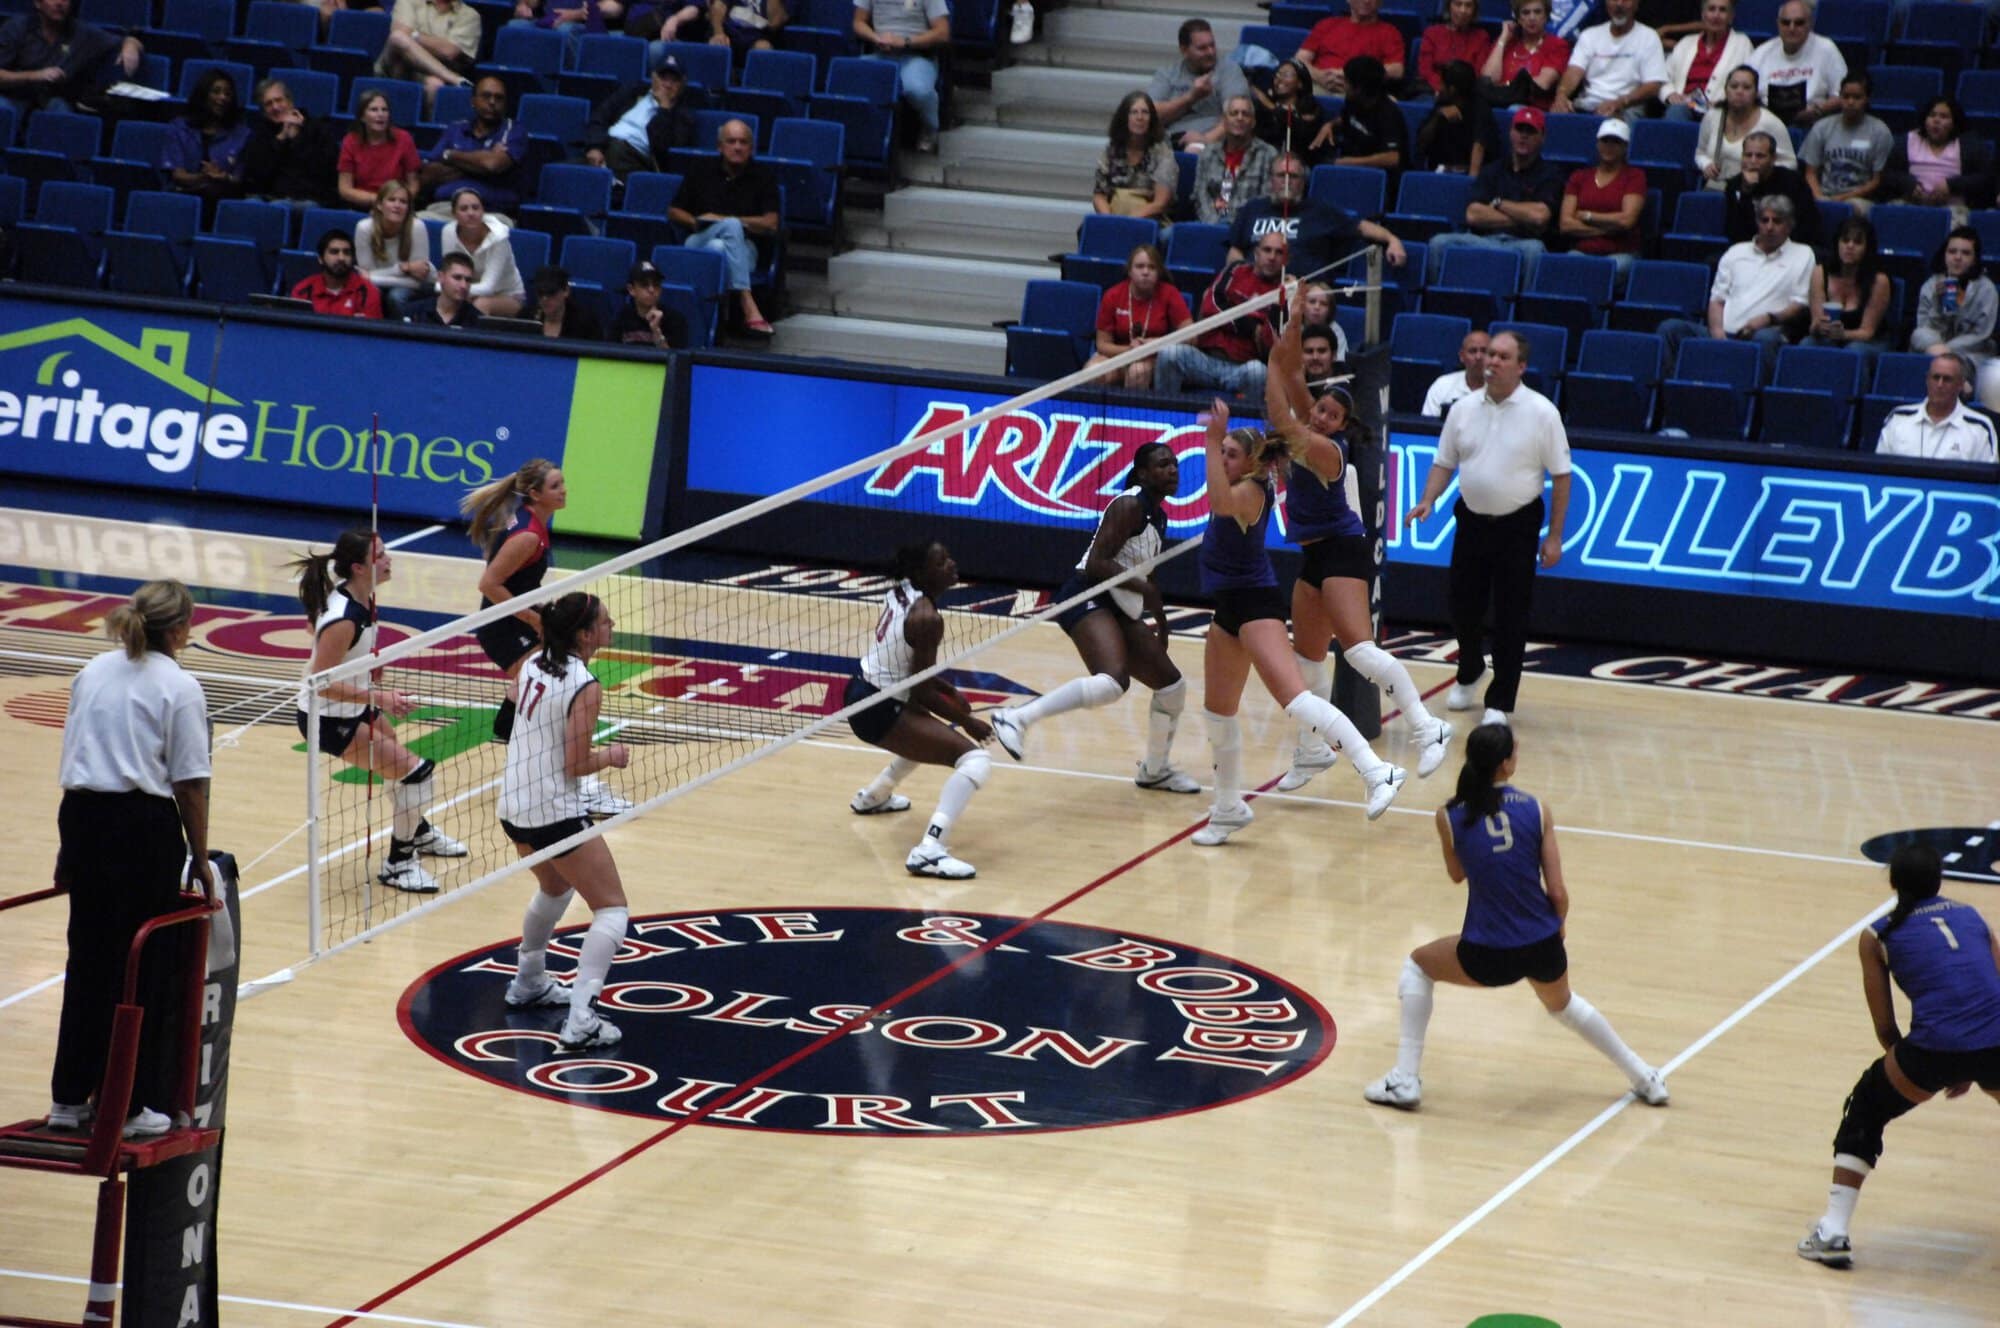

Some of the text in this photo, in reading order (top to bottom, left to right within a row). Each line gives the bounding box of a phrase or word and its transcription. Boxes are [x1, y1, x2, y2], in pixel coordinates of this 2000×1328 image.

[1252, 216, 1301, 235] UMC
[243, 399, 495, 486] Homes
[518, 675, 546, 722] 17
[1484, 810, 1514, 853] 9
[1930, 917, 1959, 950] 1
[592, 981, 1149, 1070] OLSON
[896, 915, 1029, 953] &
[1052, 937, 1308, 1077] BOBBI
[454, 1028, 1040, 1131] COURT
[177, 960, 222, 1328] RIZONA
